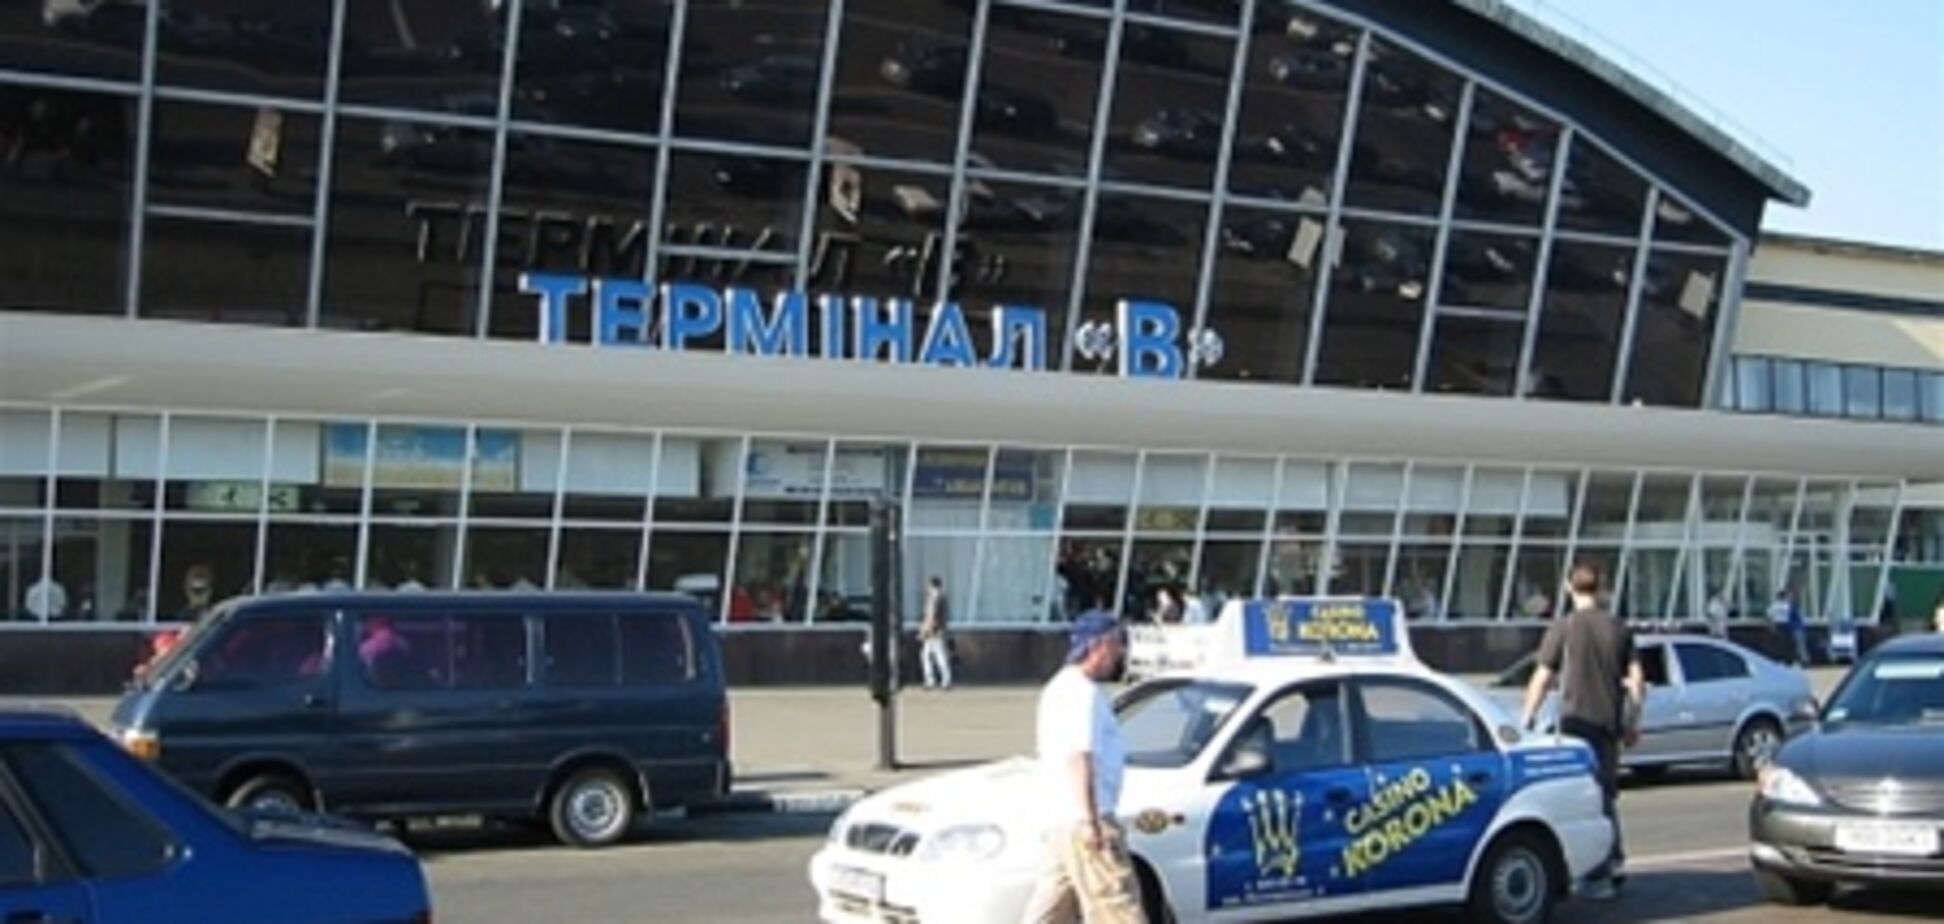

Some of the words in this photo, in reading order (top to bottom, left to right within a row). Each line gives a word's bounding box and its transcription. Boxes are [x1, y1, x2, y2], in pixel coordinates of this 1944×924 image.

[518, 272, 1048, 372] ТЕРМІНАЛ
[1342, 776, 1478, 877] KORONA
[1344, 766, 1431, 835] CASINO
